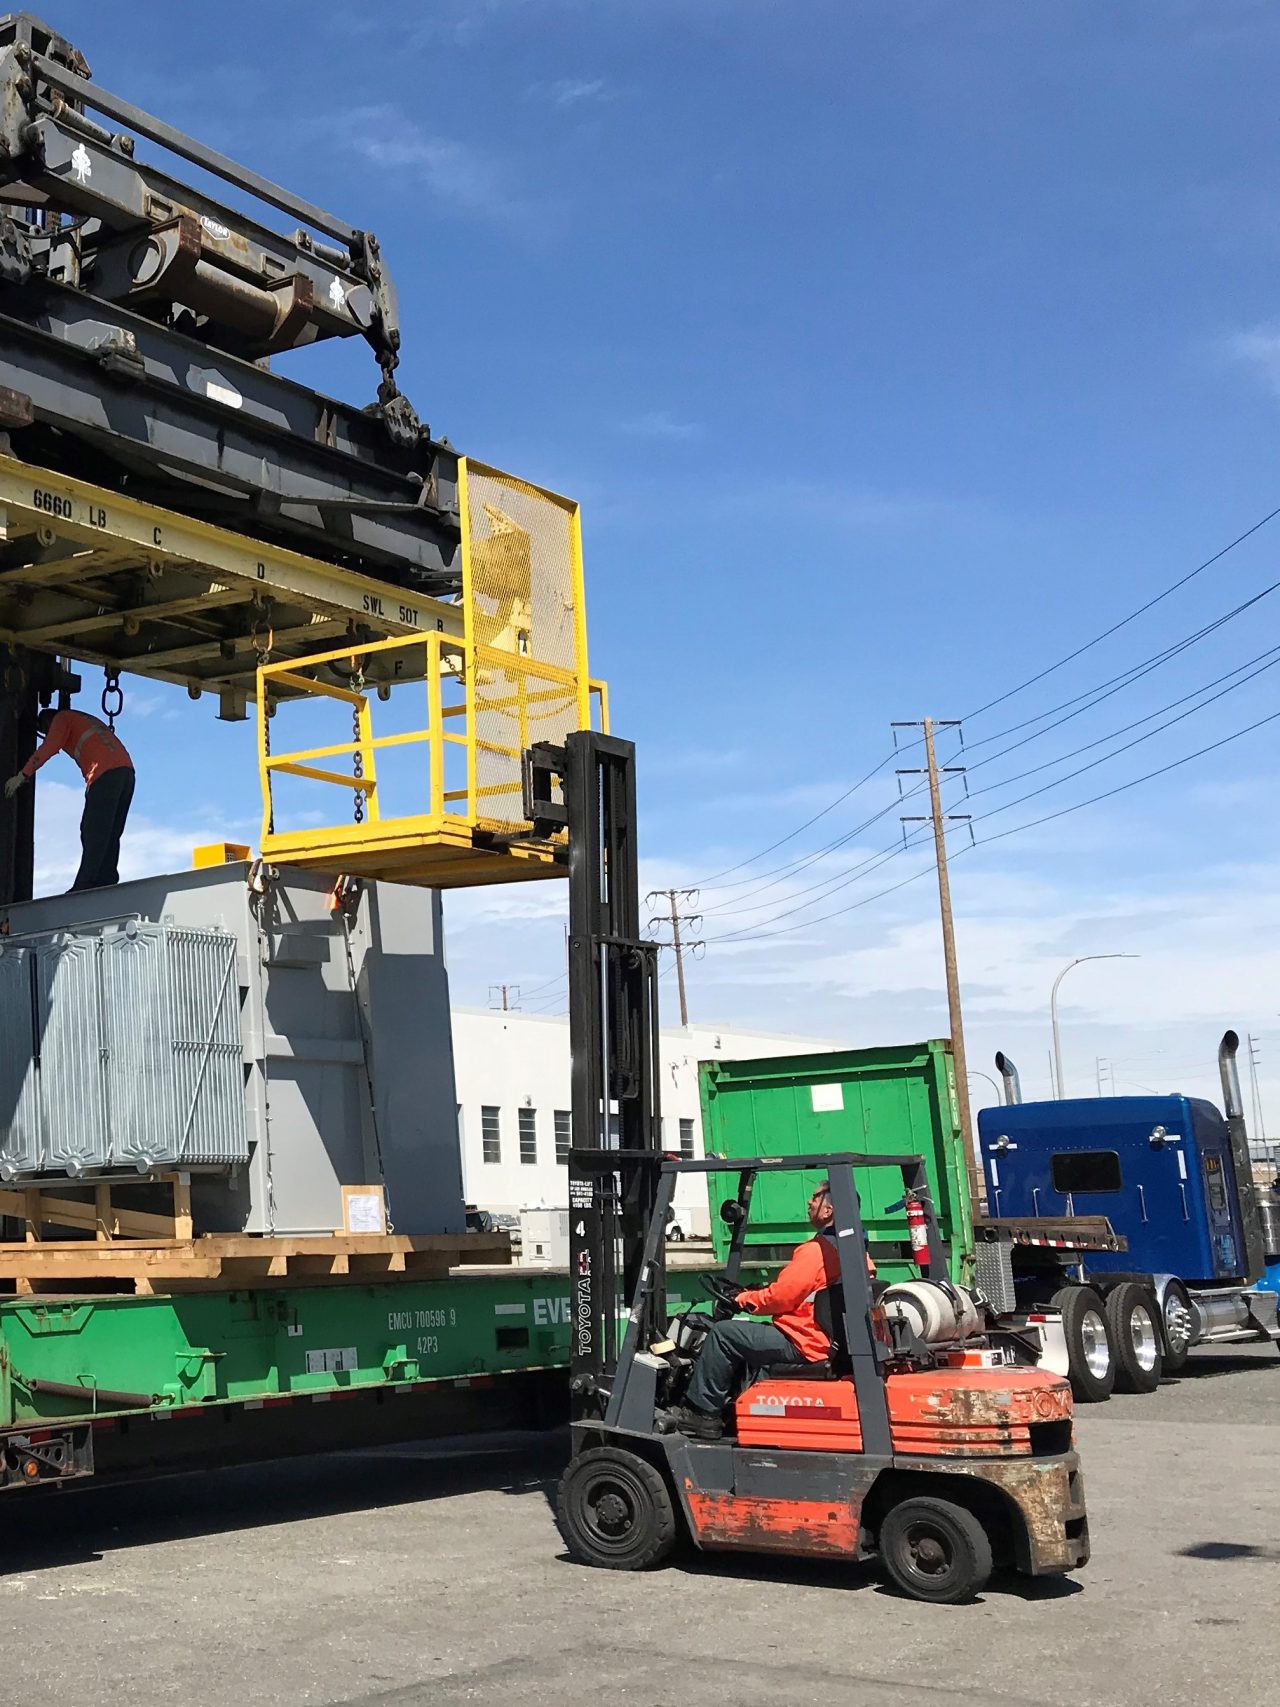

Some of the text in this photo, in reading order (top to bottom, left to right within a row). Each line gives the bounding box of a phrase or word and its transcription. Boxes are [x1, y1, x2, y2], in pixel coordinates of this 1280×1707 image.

[33, 488, 107, 529] 6660 LB
[153, 526, 162, 546] C
[257, 561, 265, 580] D
[363, 594, 418, 626] SWL 50T
[394, 660, 403, 676] F
[576, 1220, 586, 1237] 4
[388, 1308, 456, 1331] EMCU 700596 9
[578, 1277, 592, 1356] TOYOTA
[417, 1335, 438, 1355] 42P3
[756, 1395, 825, 1407] TOYOTA
